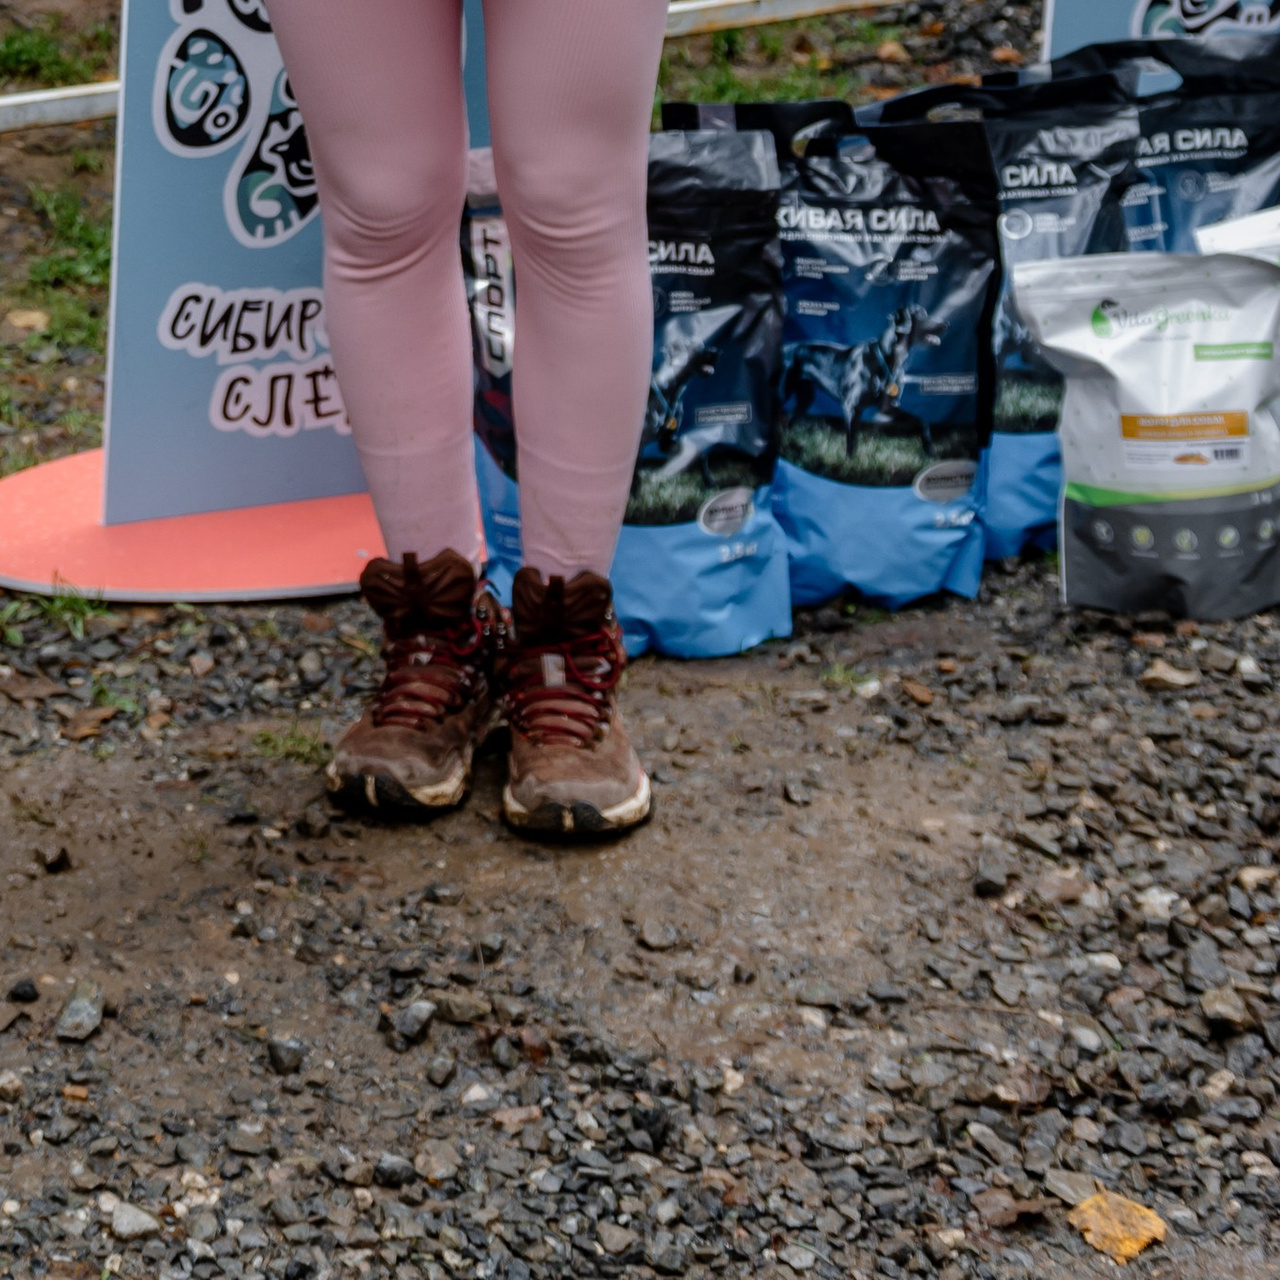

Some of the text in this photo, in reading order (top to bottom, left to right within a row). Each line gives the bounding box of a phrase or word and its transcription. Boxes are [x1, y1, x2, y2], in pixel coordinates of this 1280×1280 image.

[1173, 127, 1249, 151] СИЛА
[1001, 162, 1077, 187] СИЛА
[870, 206, 941, 232] СИЛА
[648, 240, 715, 264] СИЛА
[483, 228, 505, 363] СПОРТ
[171, 295, 322, 354] СИБИР
[223, 366, 350, 427] СЛЕ
